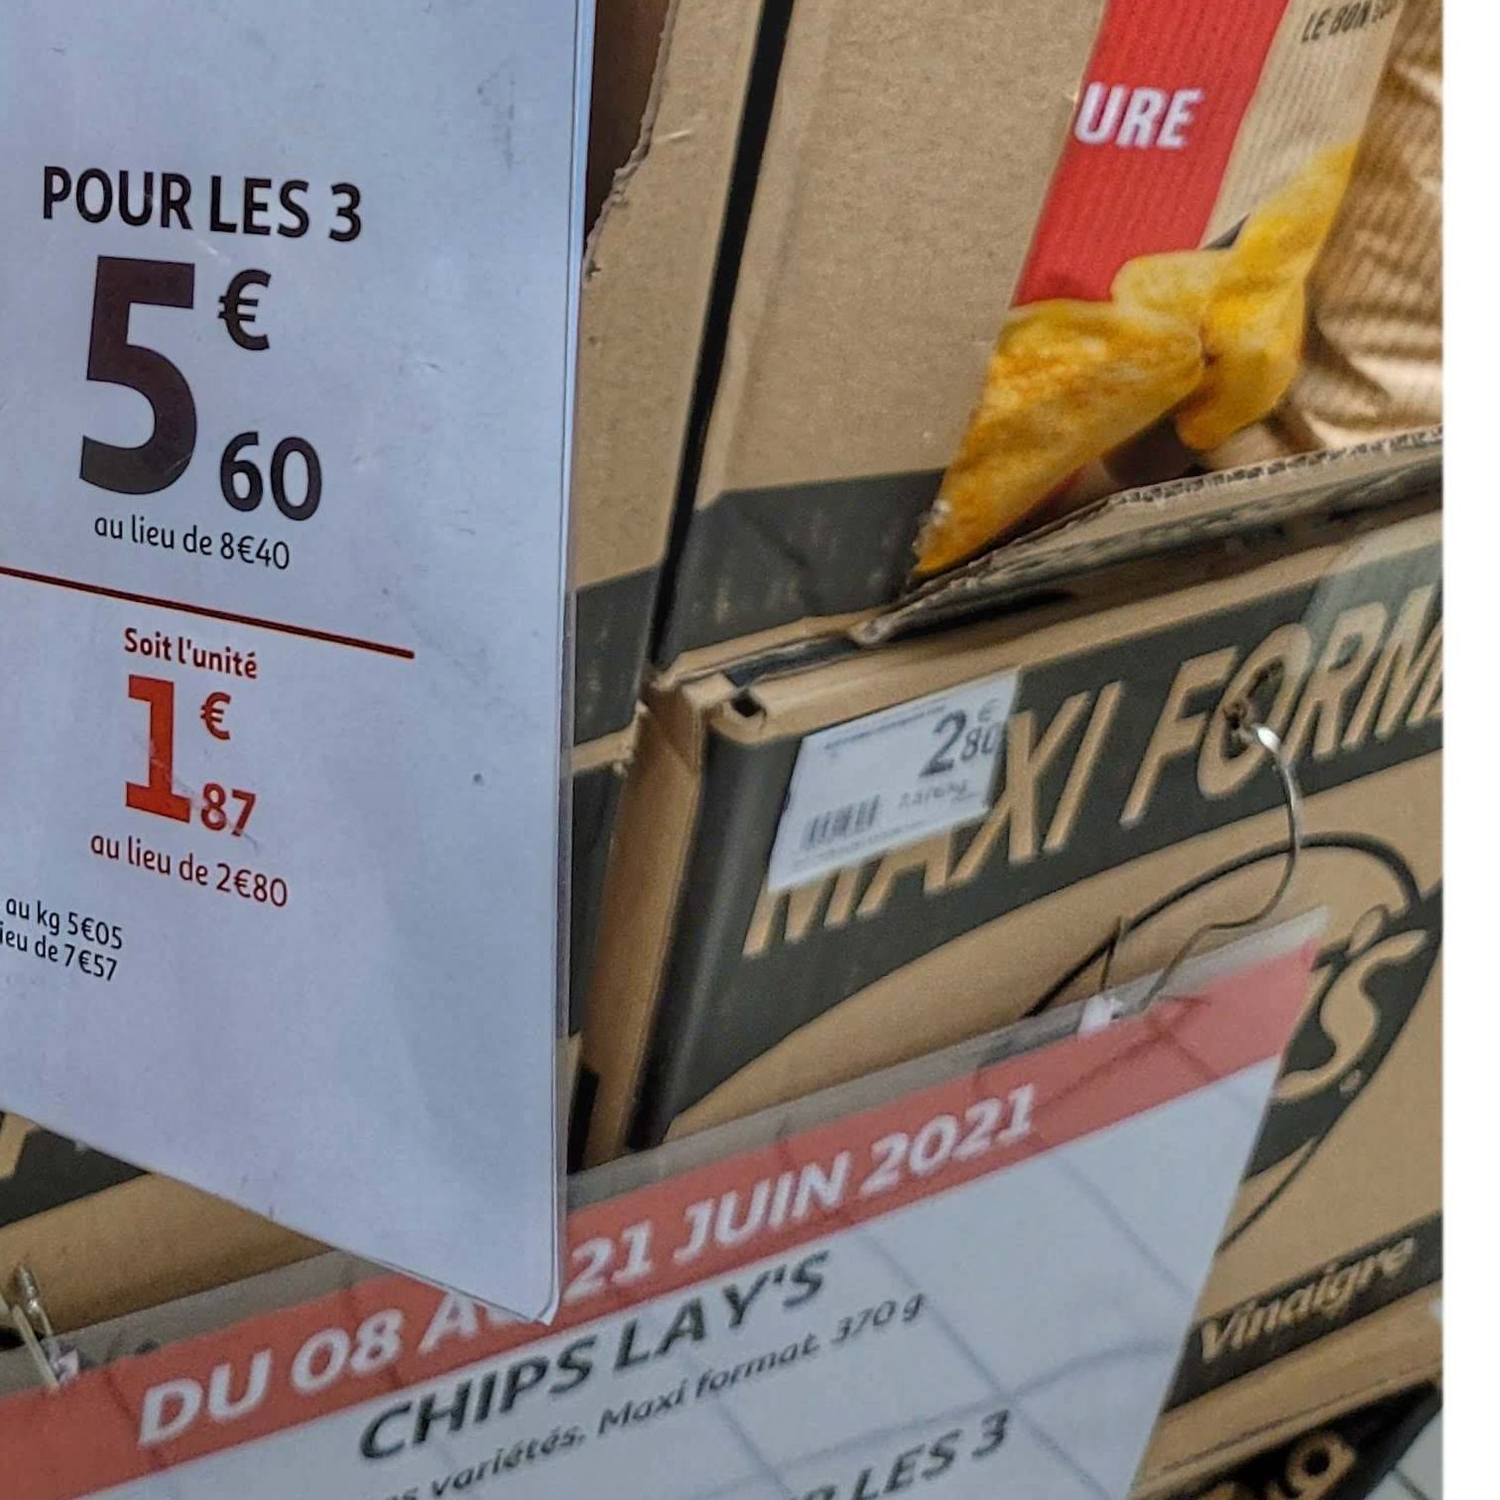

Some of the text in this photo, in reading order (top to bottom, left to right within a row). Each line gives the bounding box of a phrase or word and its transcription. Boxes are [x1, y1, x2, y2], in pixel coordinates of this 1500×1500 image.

[42, 165, 362, 243] POUR LES 3
[94, 513, 291, 571] au lieu de 8€40
[124, 626, 258, 679] Soit l'unité
[90, 834, 289, 908] au lieu de 2€80
[5, 897, 31, 921] au
[36, 901, 61, 935] kg
[67, 912, 124, 950] 5€05
[34, 934, 59, 963] de
[64, 944, 119, 983] 7€57
[137, 1348, 273, 1450] DU
[290, 1308, 406, 1396] 08
[563, 1218, 654, 1304] 21
[673, 1150, 853, 1264] JUIN
[859, 1082, 1037, 1199] 2021
[1200, 1236, 1416, 1366] Vinaigre
[358, 1250, 831, 1462] CHIPS LAY'S
[597, 1379, 688, 1438] Maxi
[829, 1299, 898, 1346] 370
[971, 1405, 1011, 1460] 3
